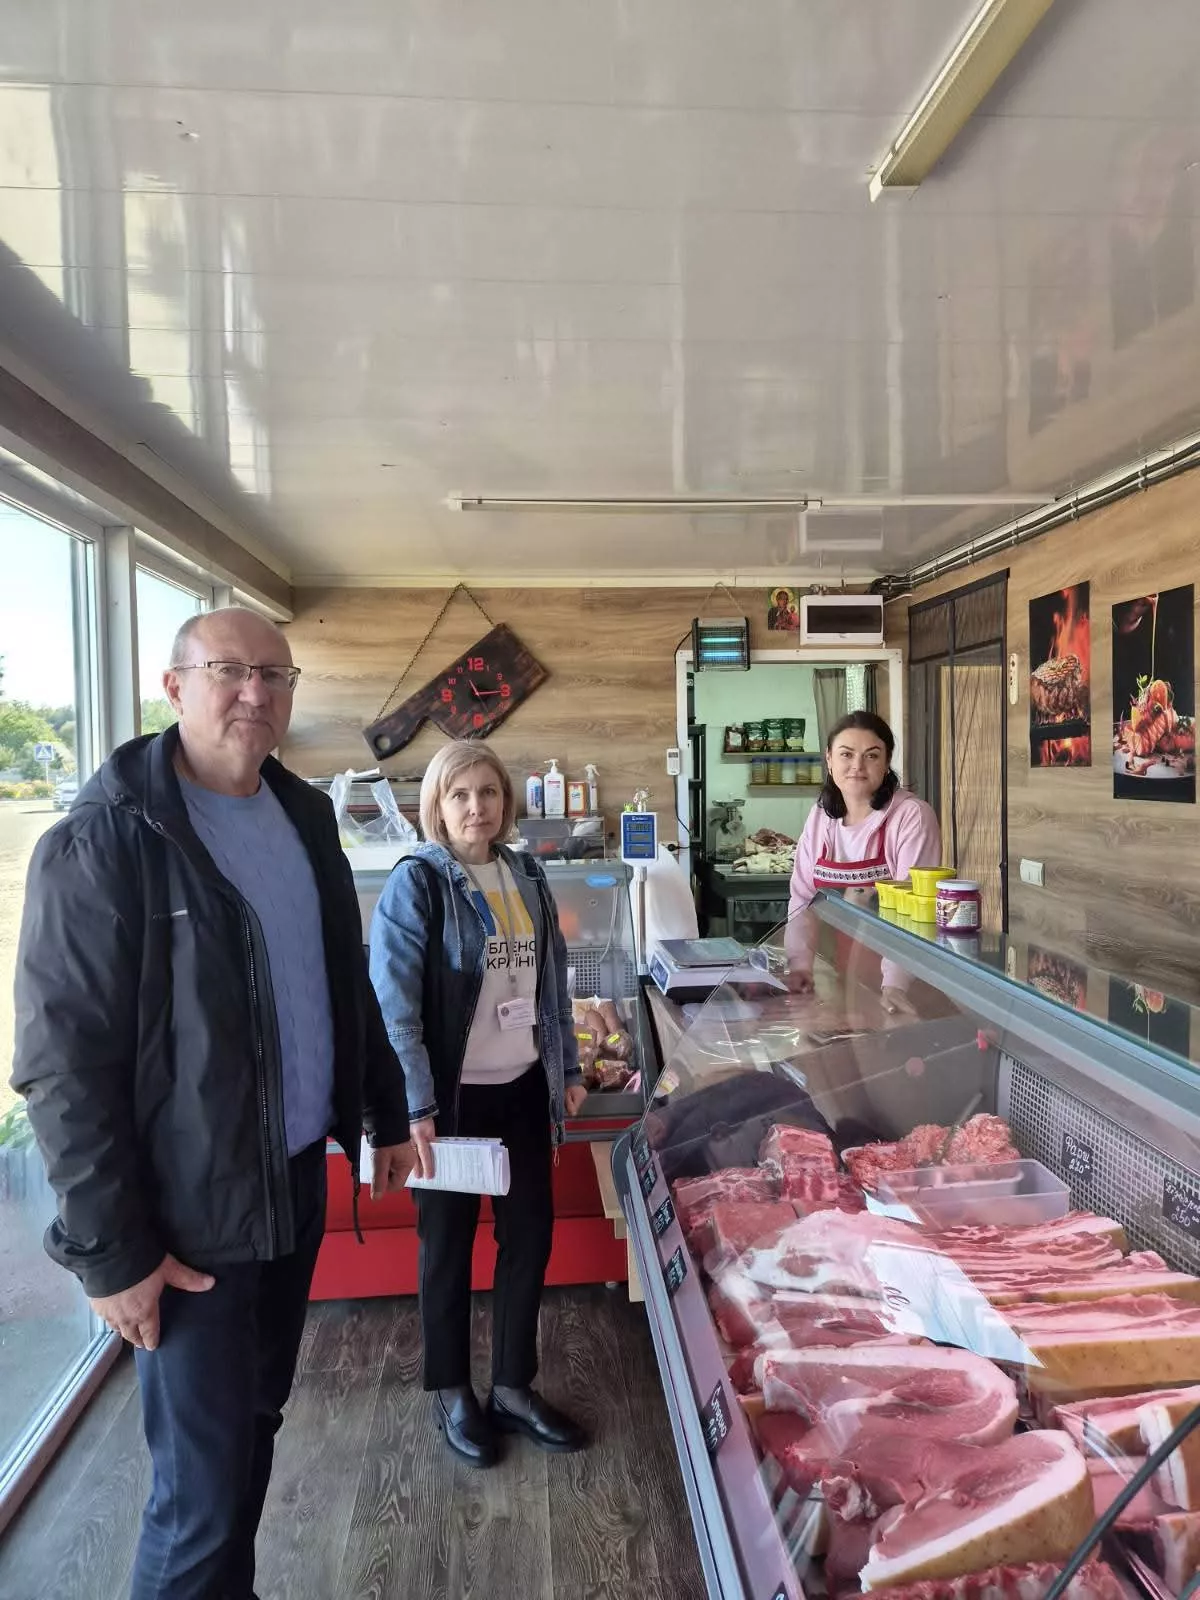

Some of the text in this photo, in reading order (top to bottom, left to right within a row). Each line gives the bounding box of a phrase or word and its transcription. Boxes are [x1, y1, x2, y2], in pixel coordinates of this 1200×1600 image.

[467, 657, 484, 671] 12
[447, 678, 456, 686] 10
[1065, 1135, 1090, 1163] Фарш
